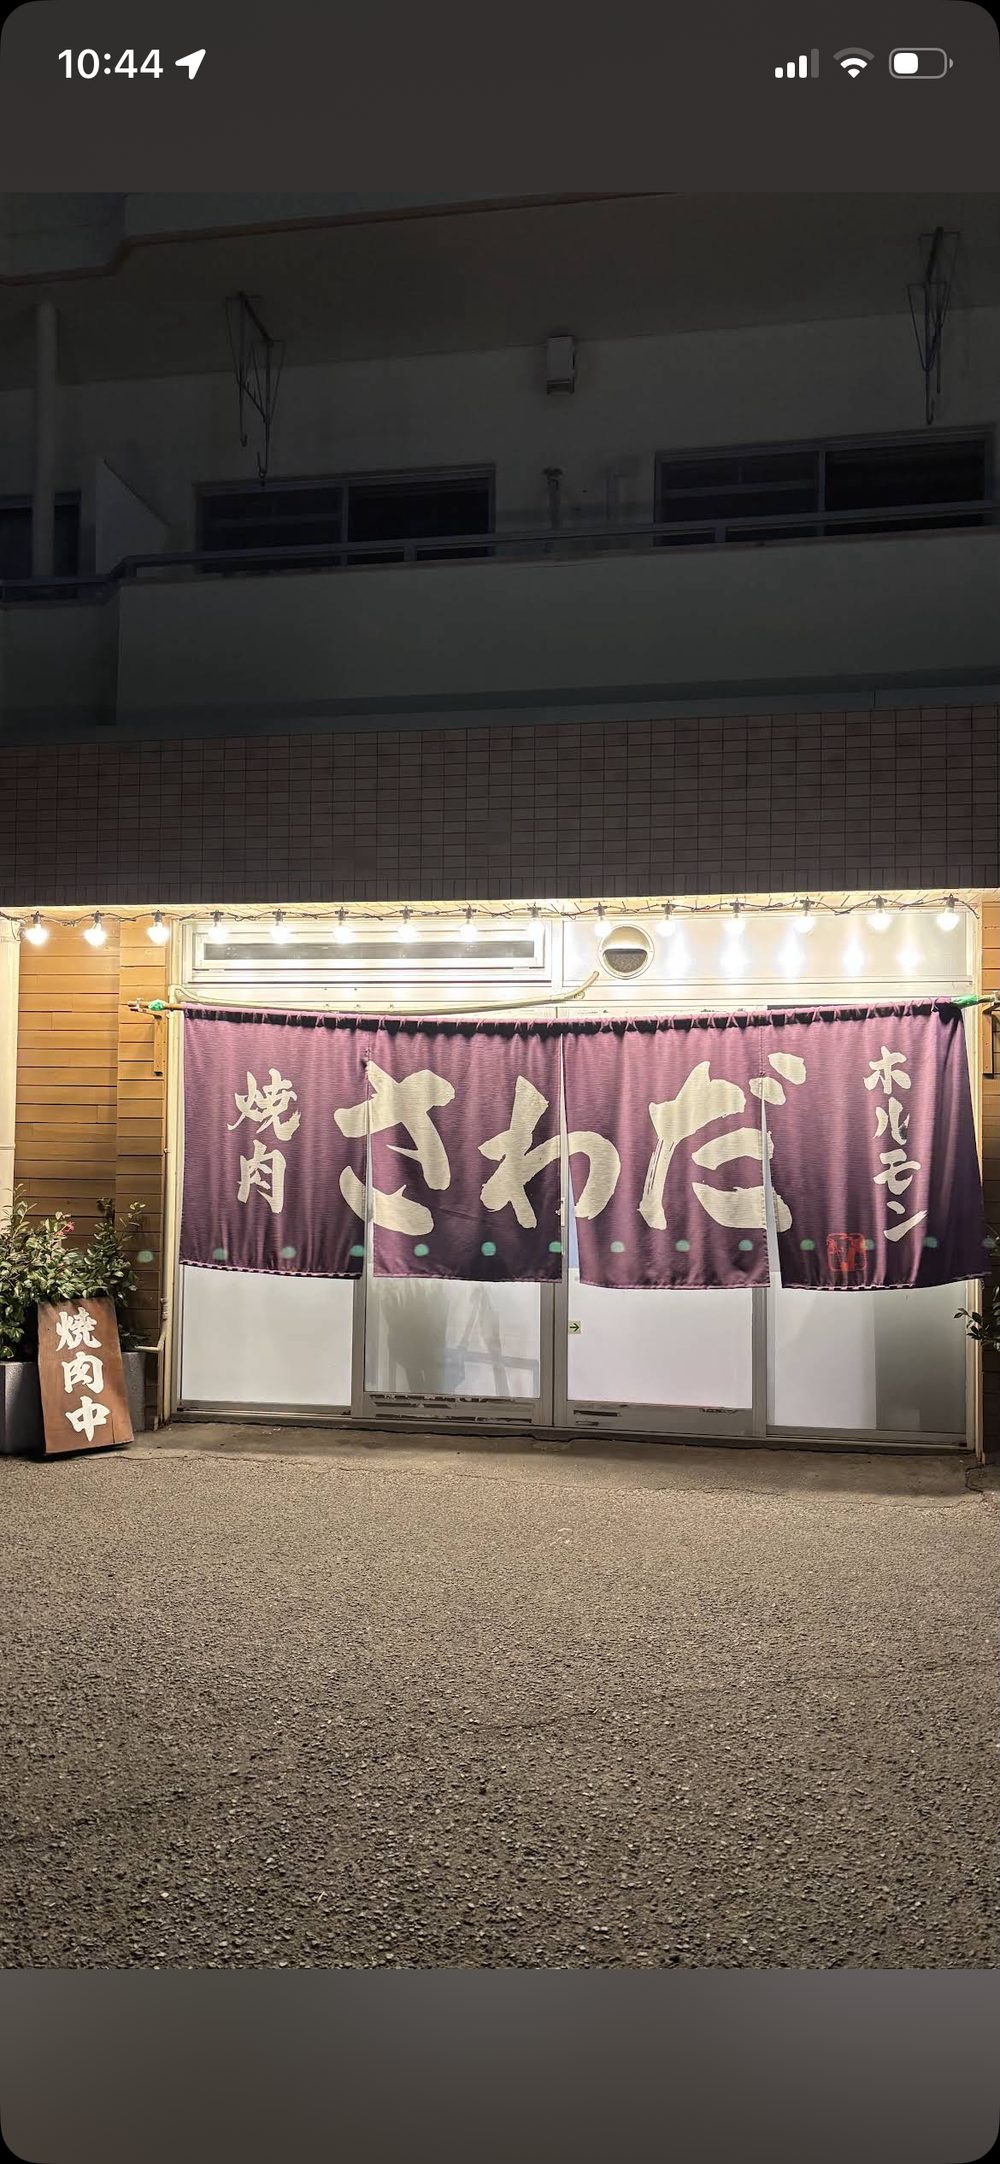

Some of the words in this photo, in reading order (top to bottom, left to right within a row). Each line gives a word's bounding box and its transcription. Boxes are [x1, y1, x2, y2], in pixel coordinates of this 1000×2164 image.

[227, 1068, 301, 1214] 焼肉
[333, 1052, 807, 1233] さわだ
[863, 1045, 928, 1242] ホルモン
[56, 1307, 110, 1442] 焼肉中
